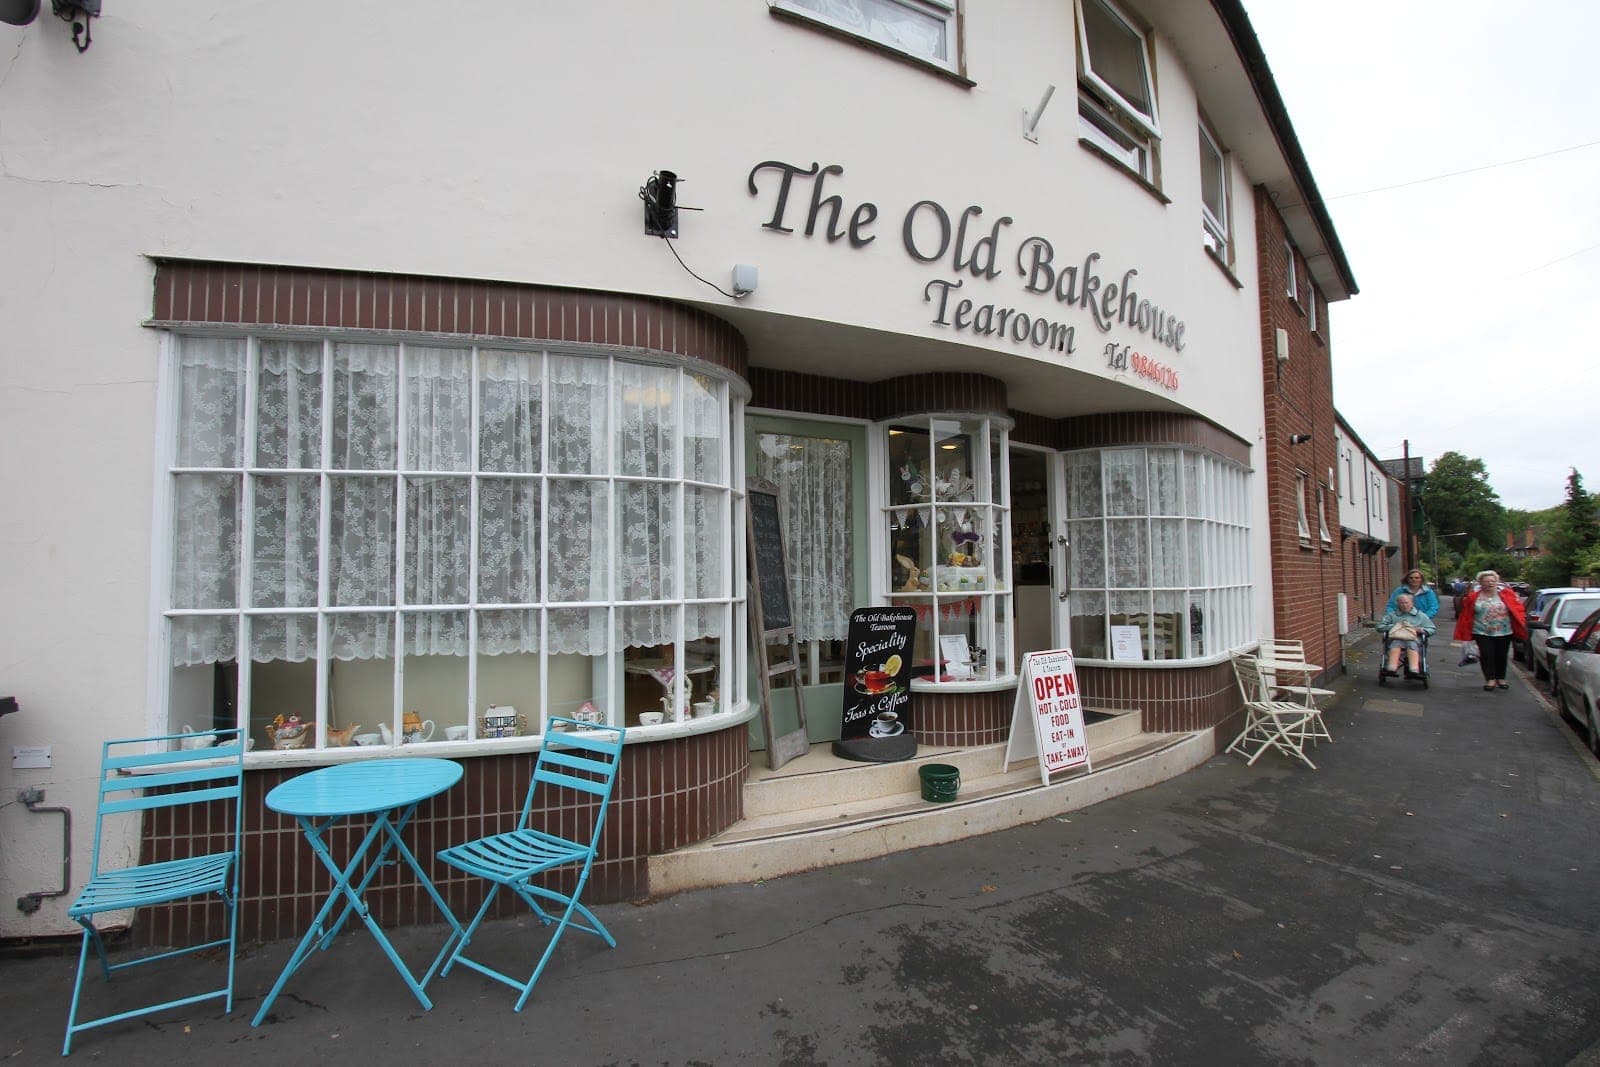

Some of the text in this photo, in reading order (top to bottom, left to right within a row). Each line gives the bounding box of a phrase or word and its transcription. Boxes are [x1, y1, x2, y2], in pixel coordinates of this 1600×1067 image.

[748, 160, 1186, 352] The Old Bakehouse
[924, 279, 1076, 355] Tearoom
[1104, 342, 1131, 370] Tel
[854, 612, 913, 622] The Old Bakehouse
[870, 623, 897, 631] Tearoom
[855, 631, 907, 661] Speciality
[1034, 673, 1075, 701] OPEN
[844, 691, 908, 723] Teas & Coffees
[1038, 698, 1077, 715] HOT & COLD
[1051, 713, 1069, 728] FOOD
[1051, 728, 1075, 743] EAT-IN
[1046, 746, 1085, 765] TAKE-AWAY
